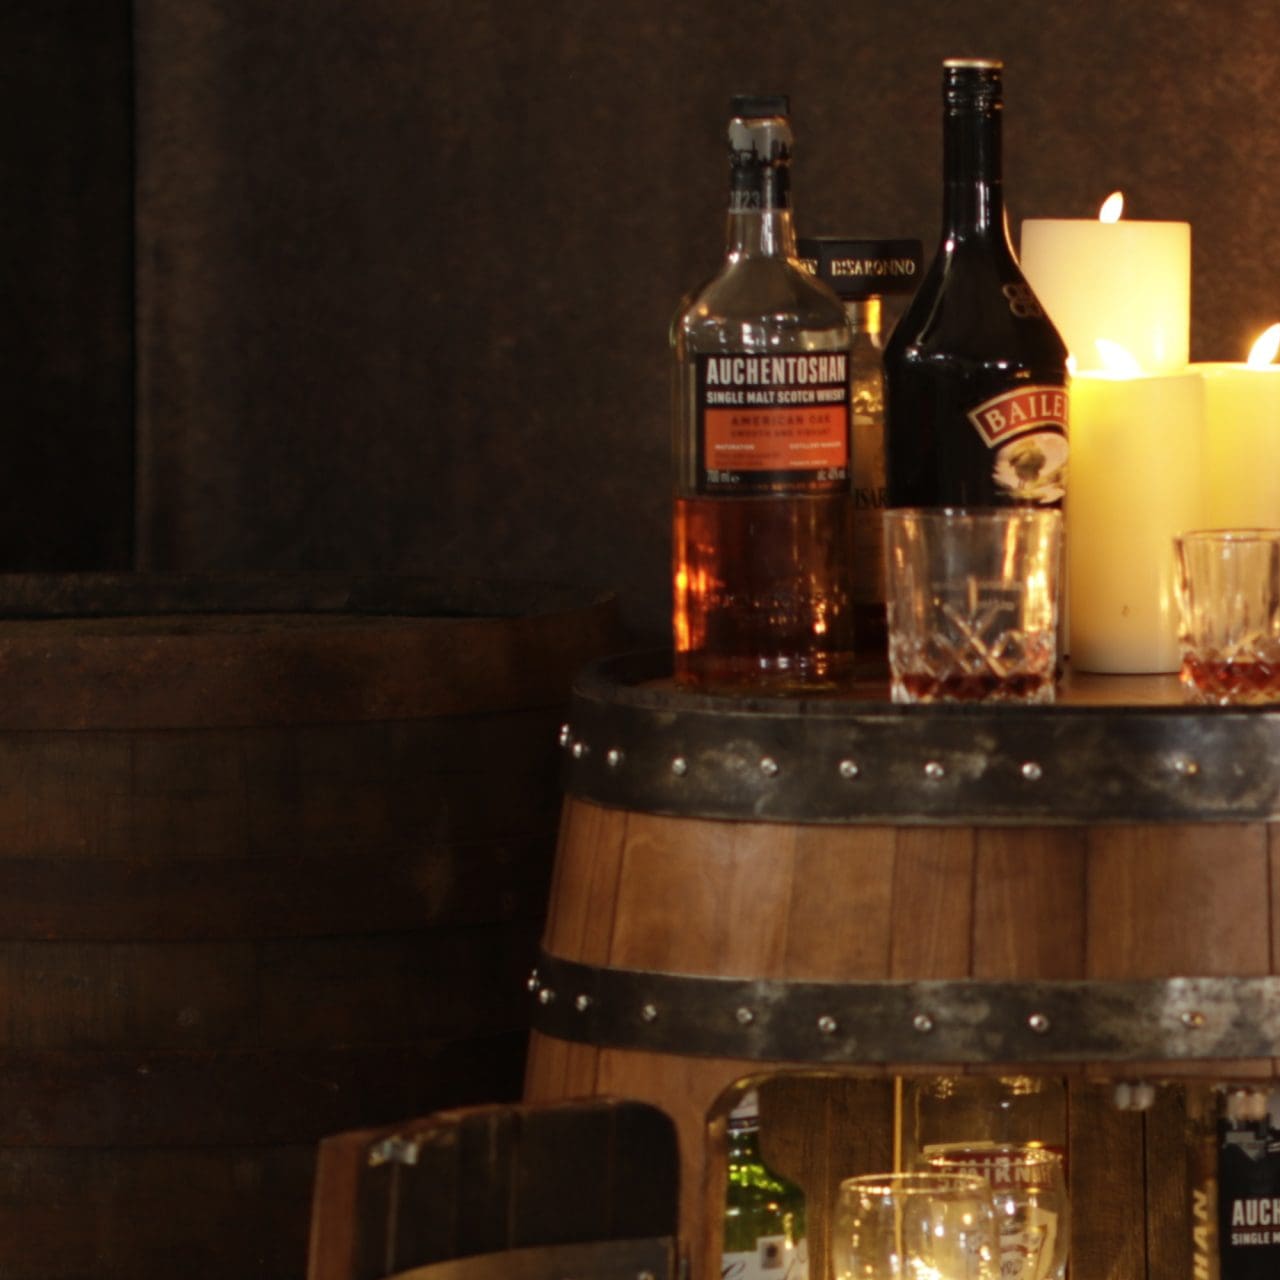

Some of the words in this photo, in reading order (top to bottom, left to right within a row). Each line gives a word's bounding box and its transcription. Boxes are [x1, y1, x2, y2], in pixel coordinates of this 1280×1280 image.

[831, 258, 916, 277] DISARONNO
[706, 355, 846, 385] AUCHENTOSHAN
[706, 391, 744, 404] SINGLE
[747, 390, 775, 404] MALT
[777, 389, 815, 403] SCOTCH
[817, 388, 846, 402] WHISKY
[1232, 1231, 1270, 1245] SINGLE
